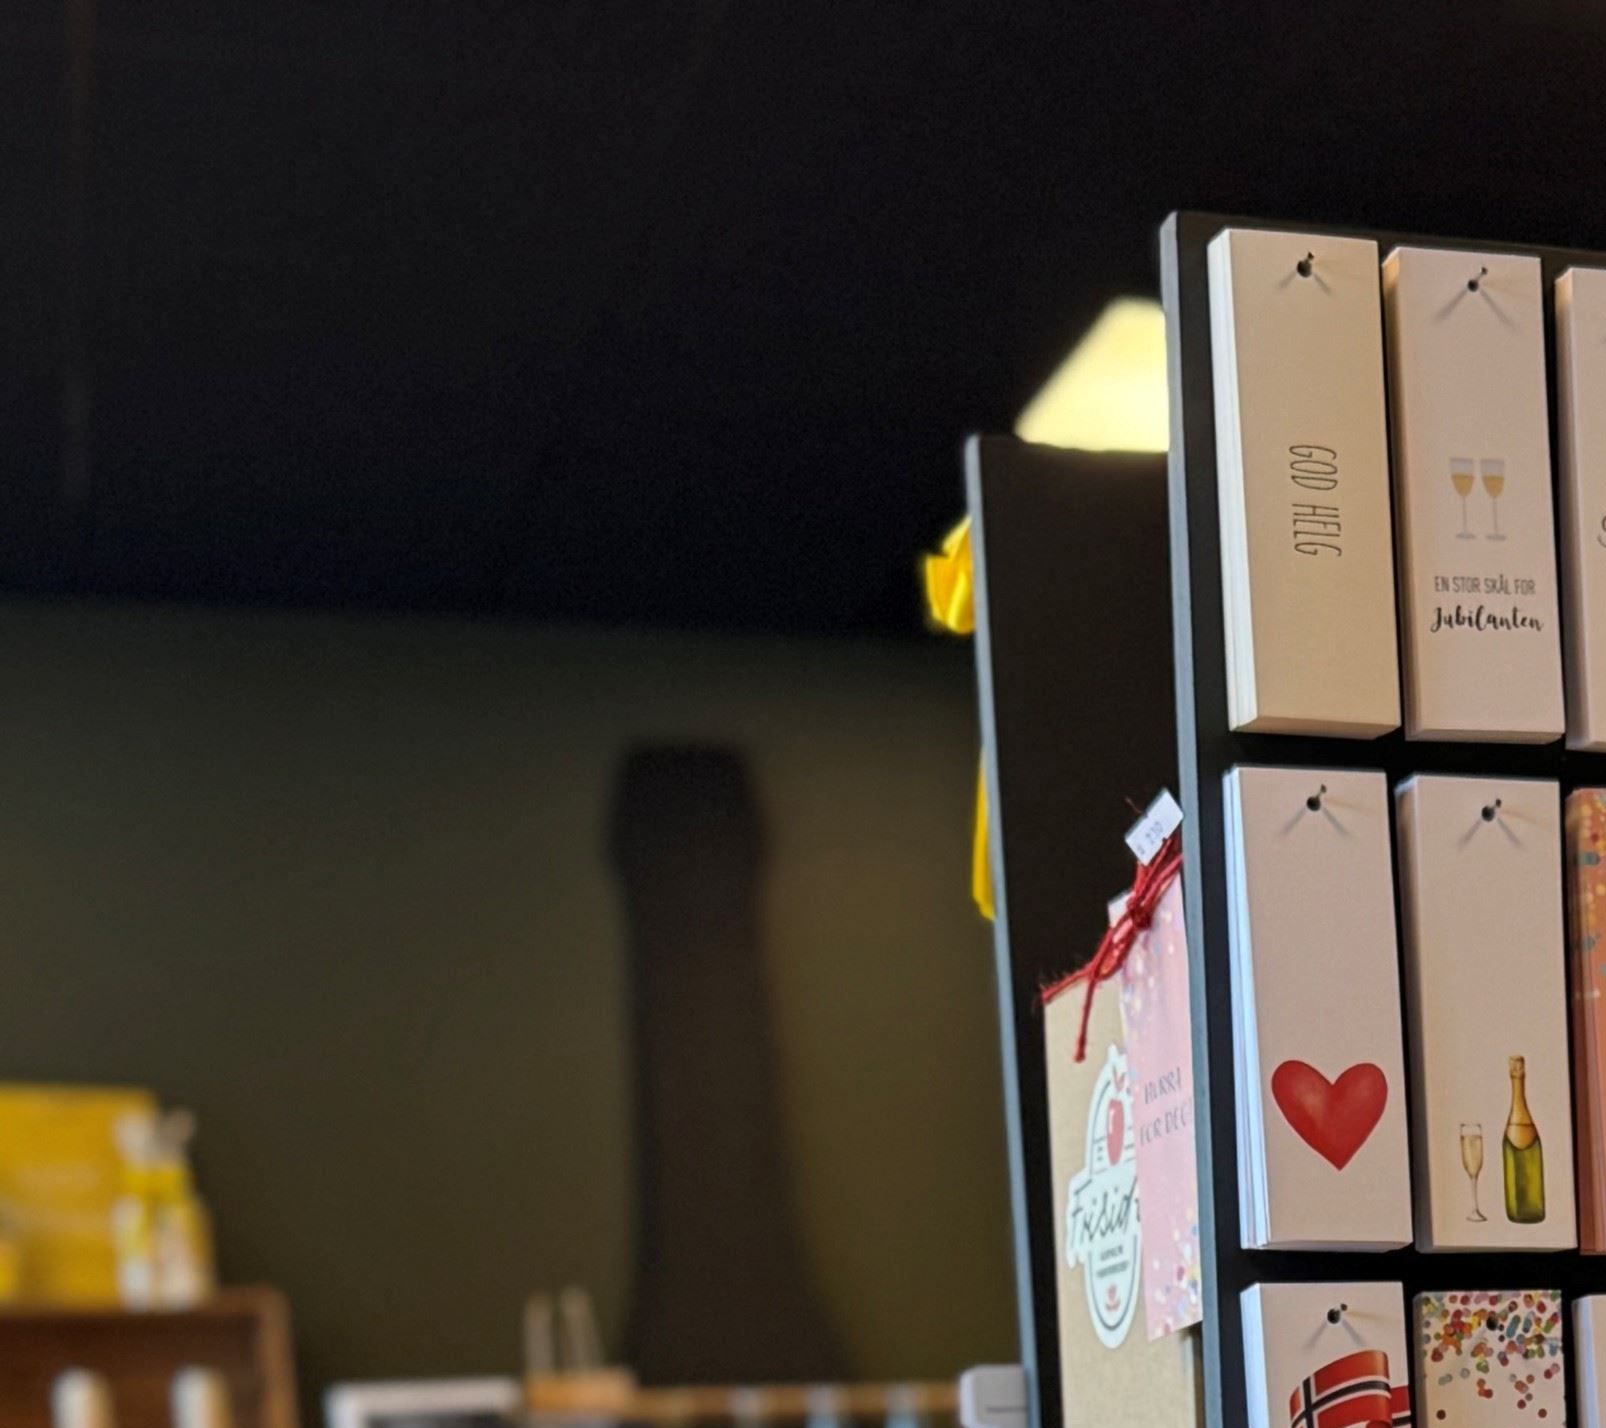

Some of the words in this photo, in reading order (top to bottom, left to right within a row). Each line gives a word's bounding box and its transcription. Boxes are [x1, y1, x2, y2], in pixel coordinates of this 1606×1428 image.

[1289, 444, 1338, 491] GOD
[1291, 502, 1343, 557] HELG
[1434, 575, 1450, 593] EN
[1452, 575, 1481, 594] STOR
[1484, 573, 1512, 596] SKÅL
[1514, 578, 1536, 596] FOR
[1431, 604, 1544, 634] Jubilanten
